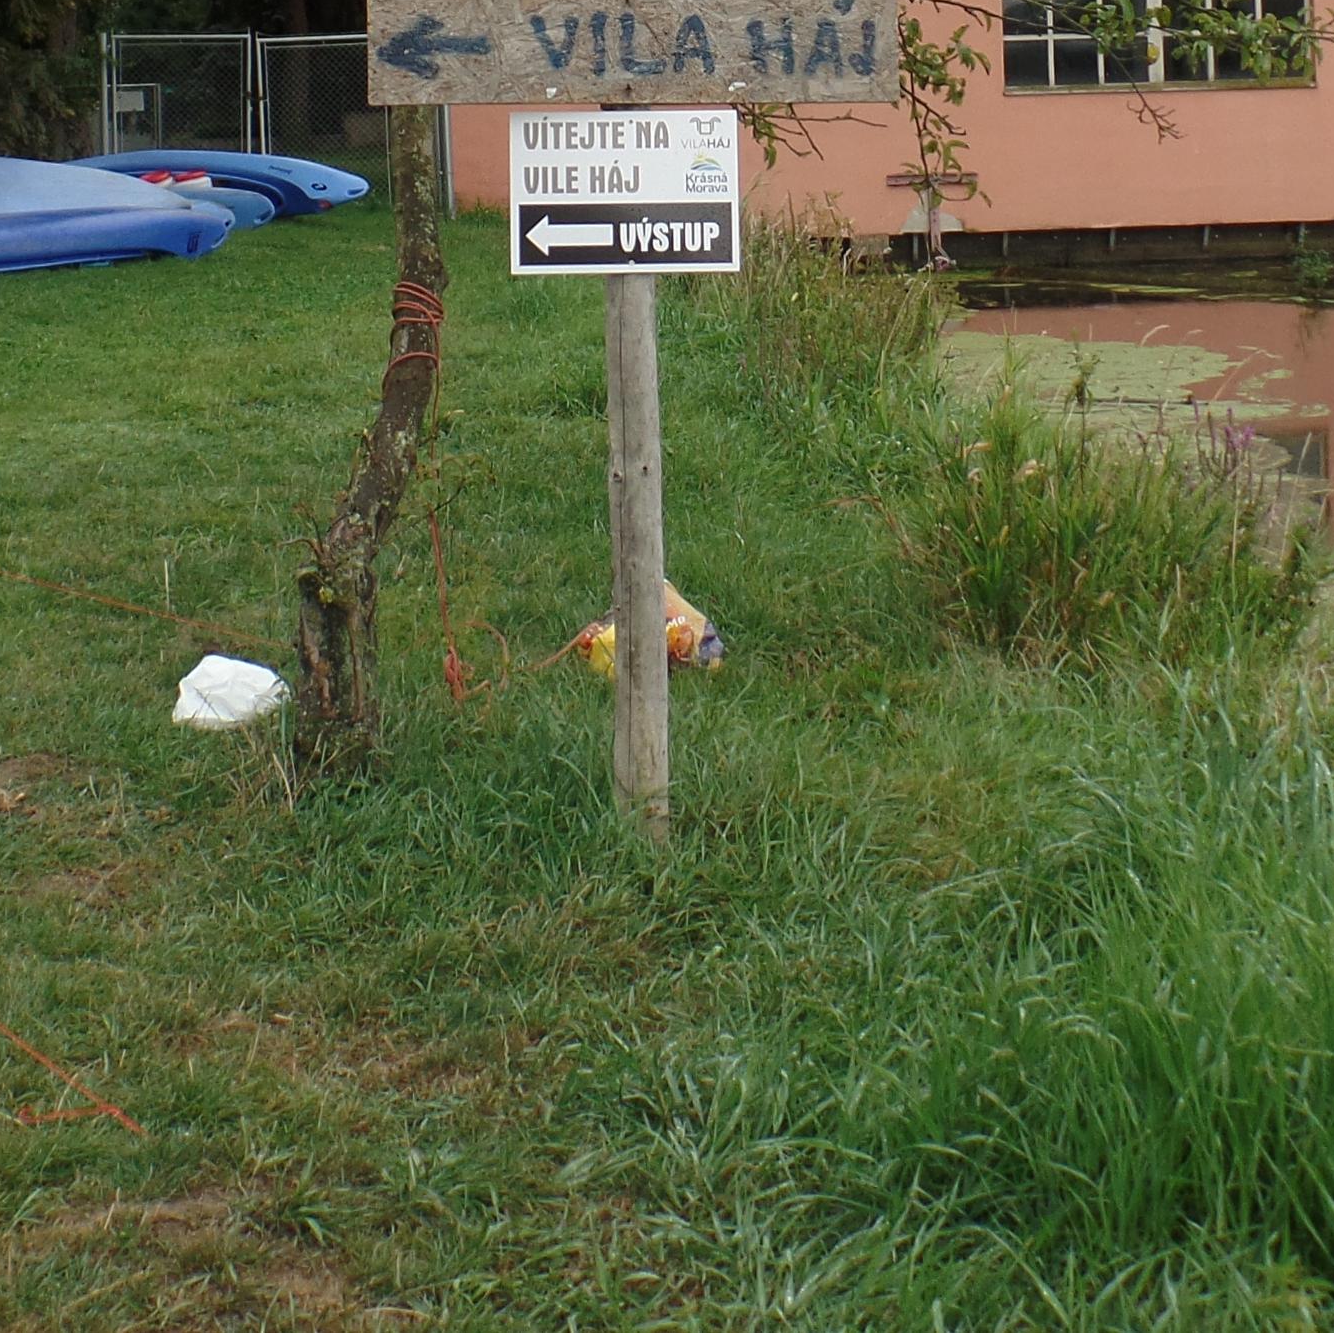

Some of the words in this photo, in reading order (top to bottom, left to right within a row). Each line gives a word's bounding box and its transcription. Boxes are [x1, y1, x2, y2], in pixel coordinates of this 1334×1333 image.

[530, 10, 716, 77] VILA
[523, 117, 625, 150] VÍTEJTE
[635, 120, 670, 149] NA
[523, 166, 579, 195] VILE
[589, 160, 641, 194] HÁJ
[685, 171, 728, 184] Krásná
[685, 183, 728, 194] Morava
[619, 217, 720, 253] VÝSTUP
